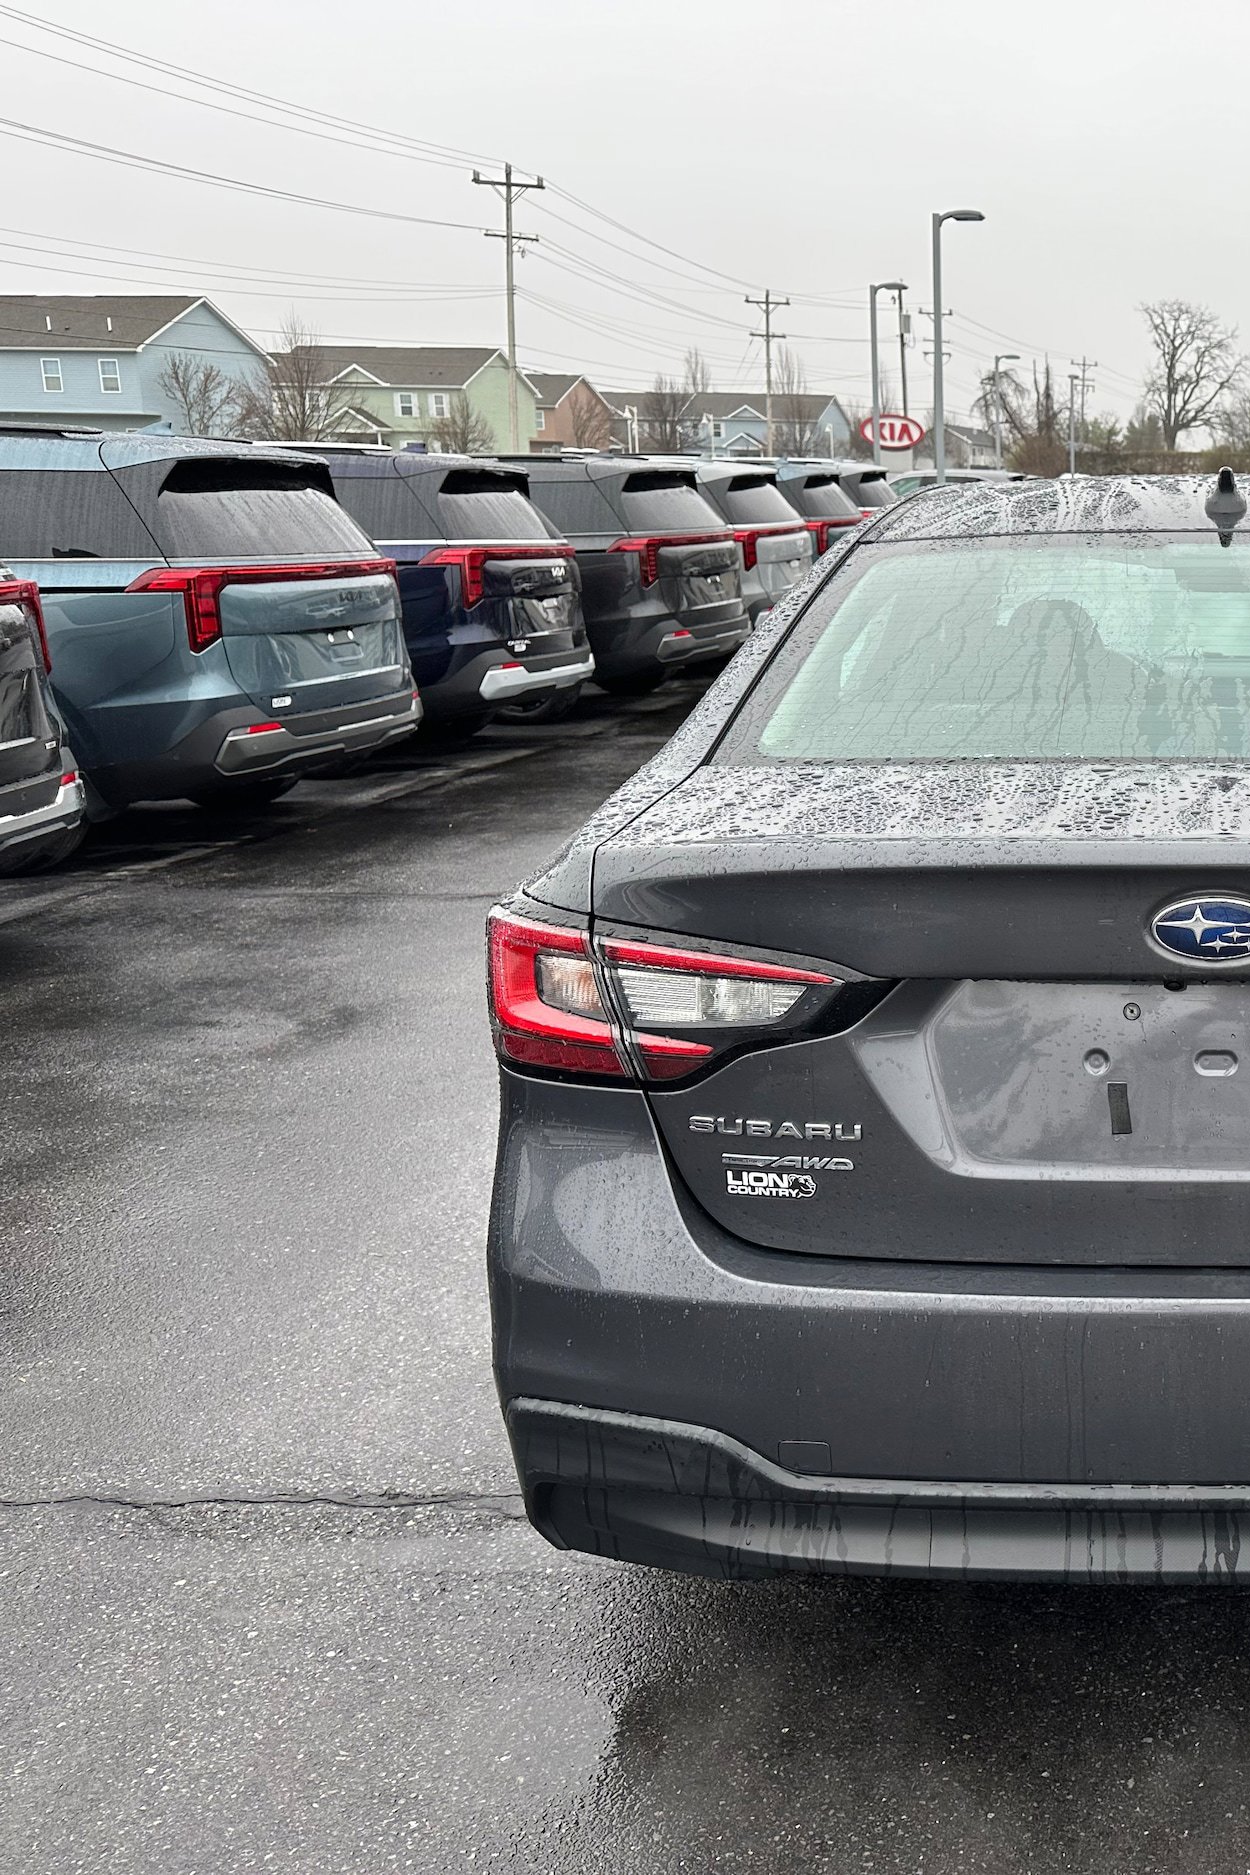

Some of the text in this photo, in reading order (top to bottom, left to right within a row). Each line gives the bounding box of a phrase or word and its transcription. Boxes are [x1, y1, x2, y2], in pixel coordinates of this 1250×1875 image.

[688, 1115, 863, 1142] SUBARU
[771, 1155, 855, 1171] AWD
[727, 1170, 790, 1189] LION
[727, 1185, 800, 1198] COUNTRY
